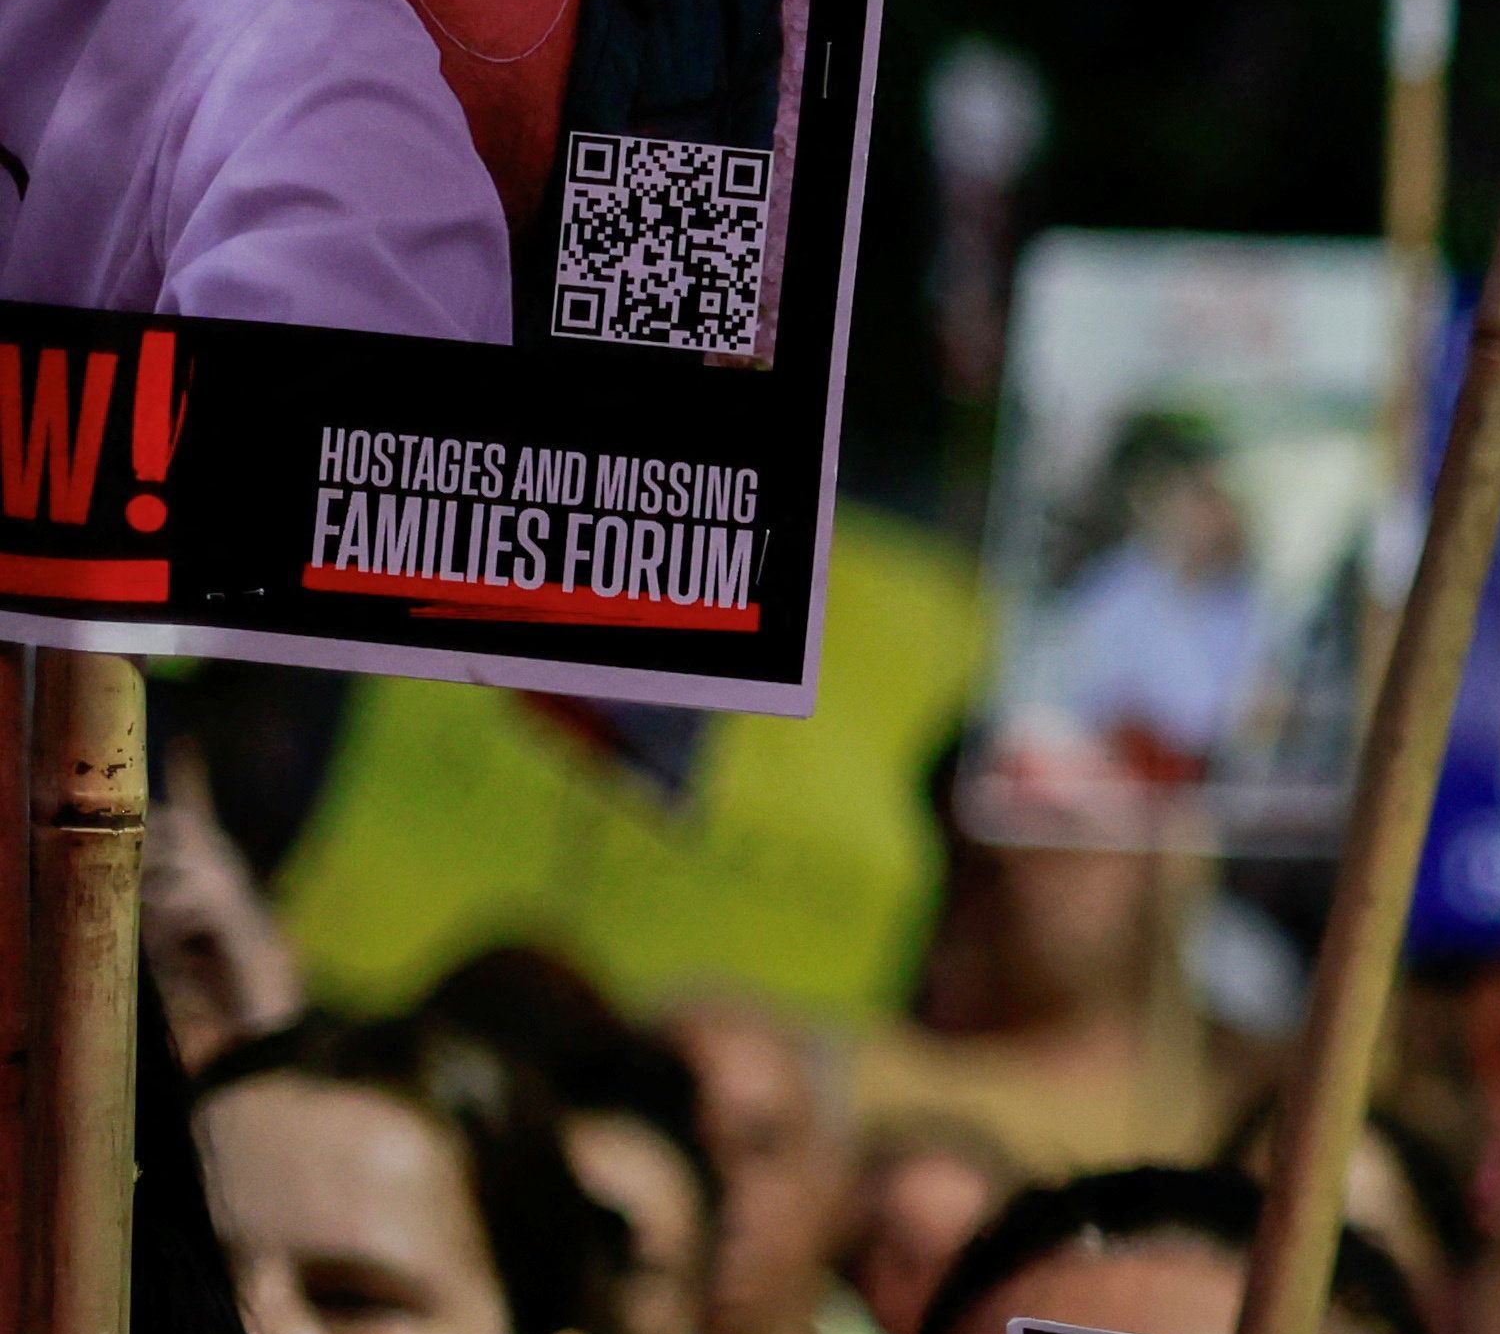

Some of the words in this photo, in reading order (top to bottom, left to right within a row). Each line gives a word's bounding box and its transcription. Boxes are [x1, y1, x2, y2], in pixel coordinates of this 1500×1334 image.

[319, 426, 506, 498] HOSTAGES
[511, 446, 587, 506] AND
[594, 454, 758, 524] MISSING
[311, 488, 551, 591] FAMILIES
[562, 512, 755, 610] FORUM
